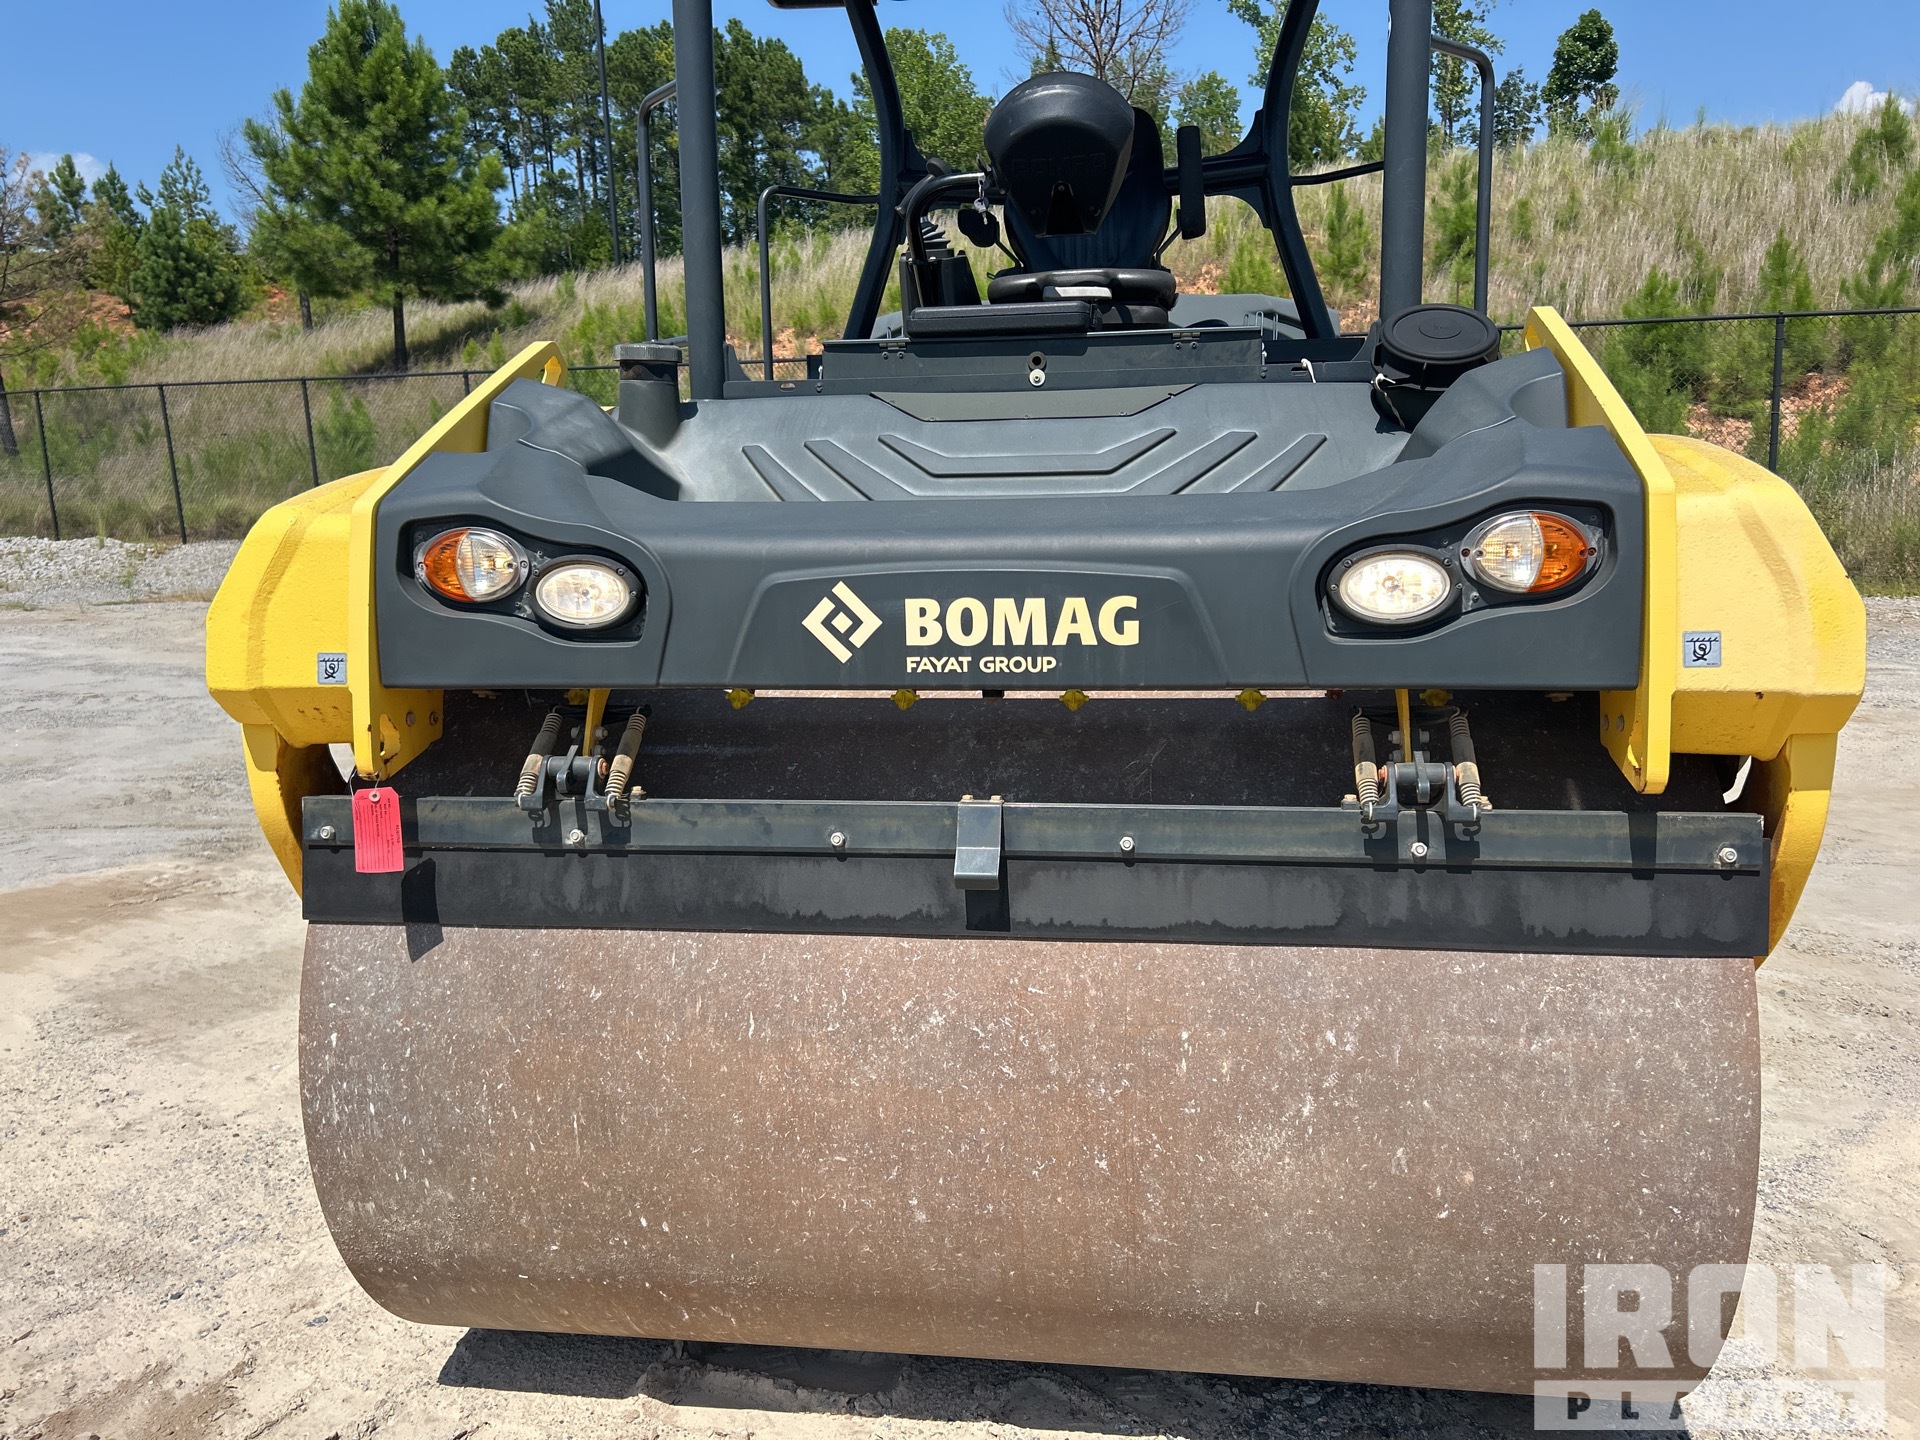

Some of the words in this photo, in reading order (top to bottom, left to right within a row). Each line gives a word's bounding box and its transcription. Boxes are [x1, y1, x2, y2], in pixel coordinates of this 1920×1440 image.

[904, 595, 1140, 647] BOMAG
[905, 656, 972, 673] FAYAT
[978, 656, 1057, 673] GROUP
